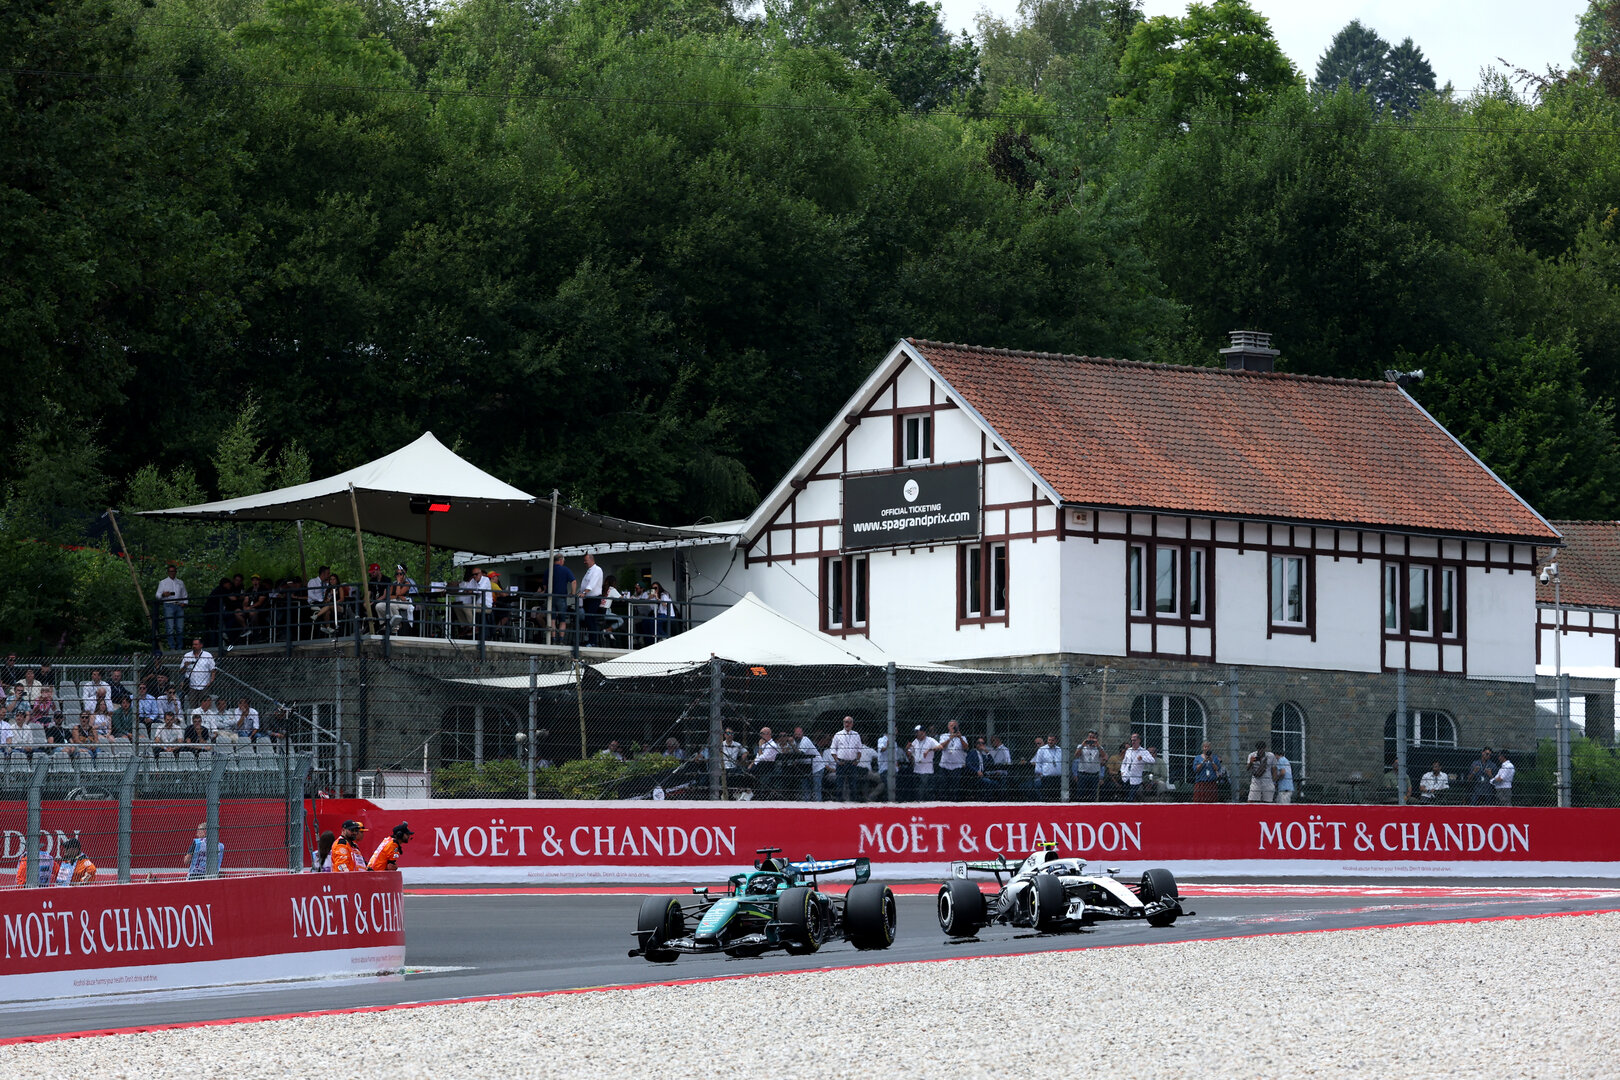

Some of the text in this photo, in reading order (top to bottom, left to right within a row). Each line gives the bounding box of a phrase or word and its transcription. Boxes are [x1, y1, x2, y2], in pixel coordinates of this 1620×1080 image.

[853, 511, 970, 533] www.spagrandprix.com
[881, 503, 942, 517] OFFICIAL TICKETING
[433, 818, 737, 857] MOËT & CHANDON
[858, 816, 1143, 853] MOËT & CHANDON
[1258, 815, 1530, 852] MOËT & CHANDON
[4, 901, 214, 959] MOËT & CHANDON
[290, 885, 349, 938] MOËT
[354, 892, 369, 935] &
